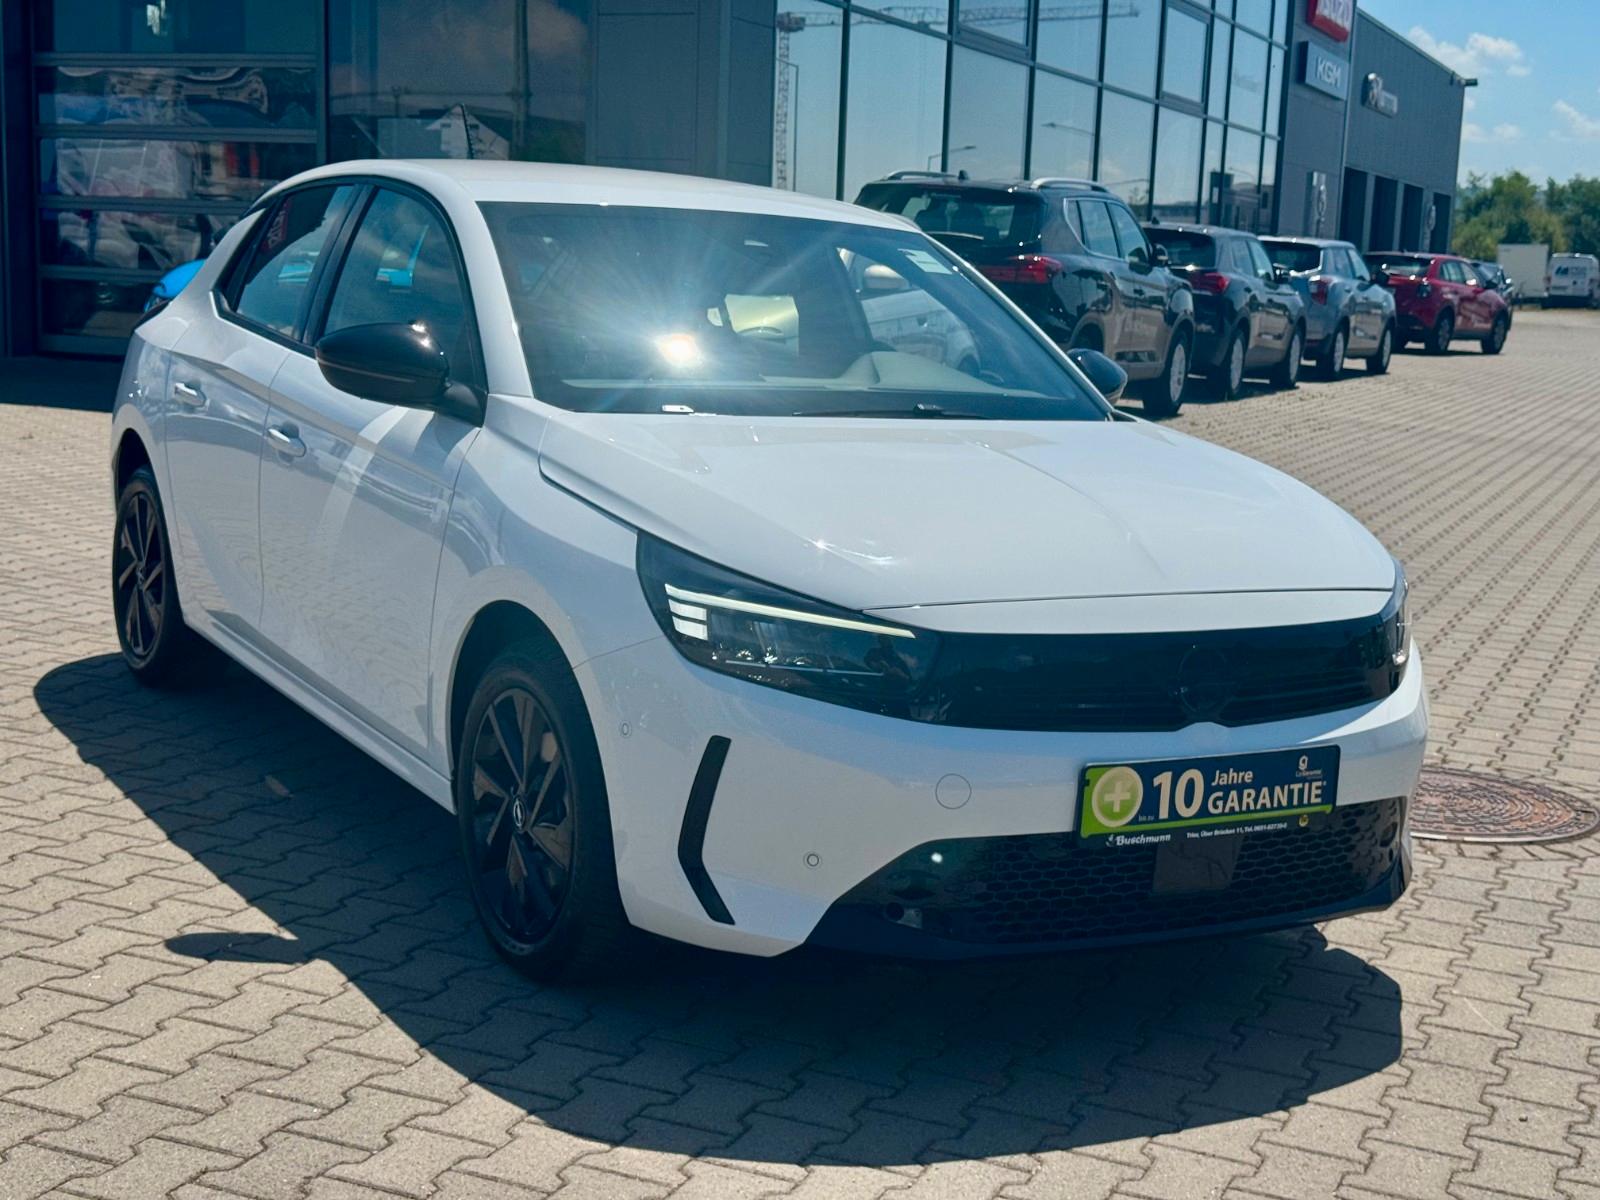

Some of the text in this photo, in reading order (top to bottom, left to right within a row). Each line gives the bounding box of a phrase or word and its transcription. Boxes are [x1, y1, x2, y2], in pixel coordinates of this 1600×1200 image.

[1316, 55, 1342, 88] KGM
[1211, 768, 1253, 786] Jahre
[1153, 768, 1204, 819] 10
[1115, 833, 1171, 846] Buschmann
